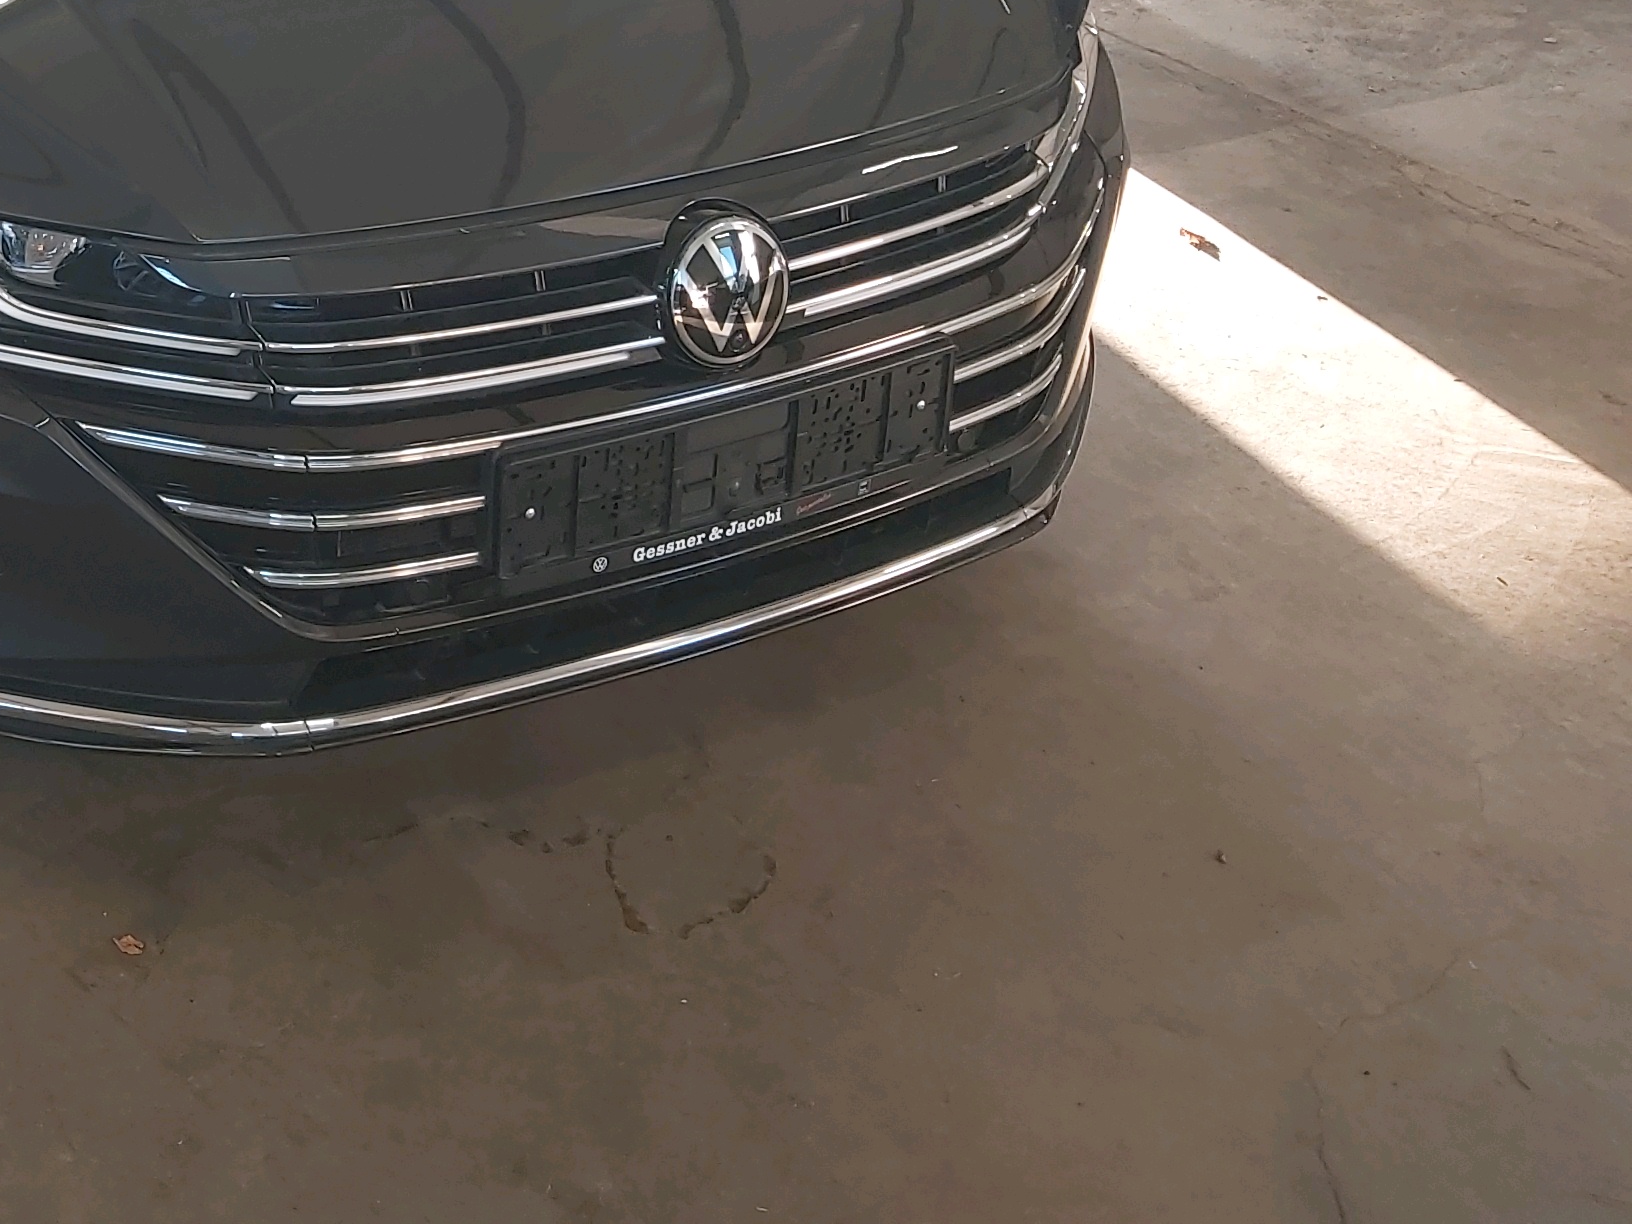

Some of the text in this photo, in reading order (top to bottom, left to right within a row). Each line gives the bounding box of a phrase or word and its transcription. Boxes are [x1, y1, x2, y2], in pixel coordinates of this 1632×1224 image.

[632, 506, 782, 562] Gessner & Jacobi
